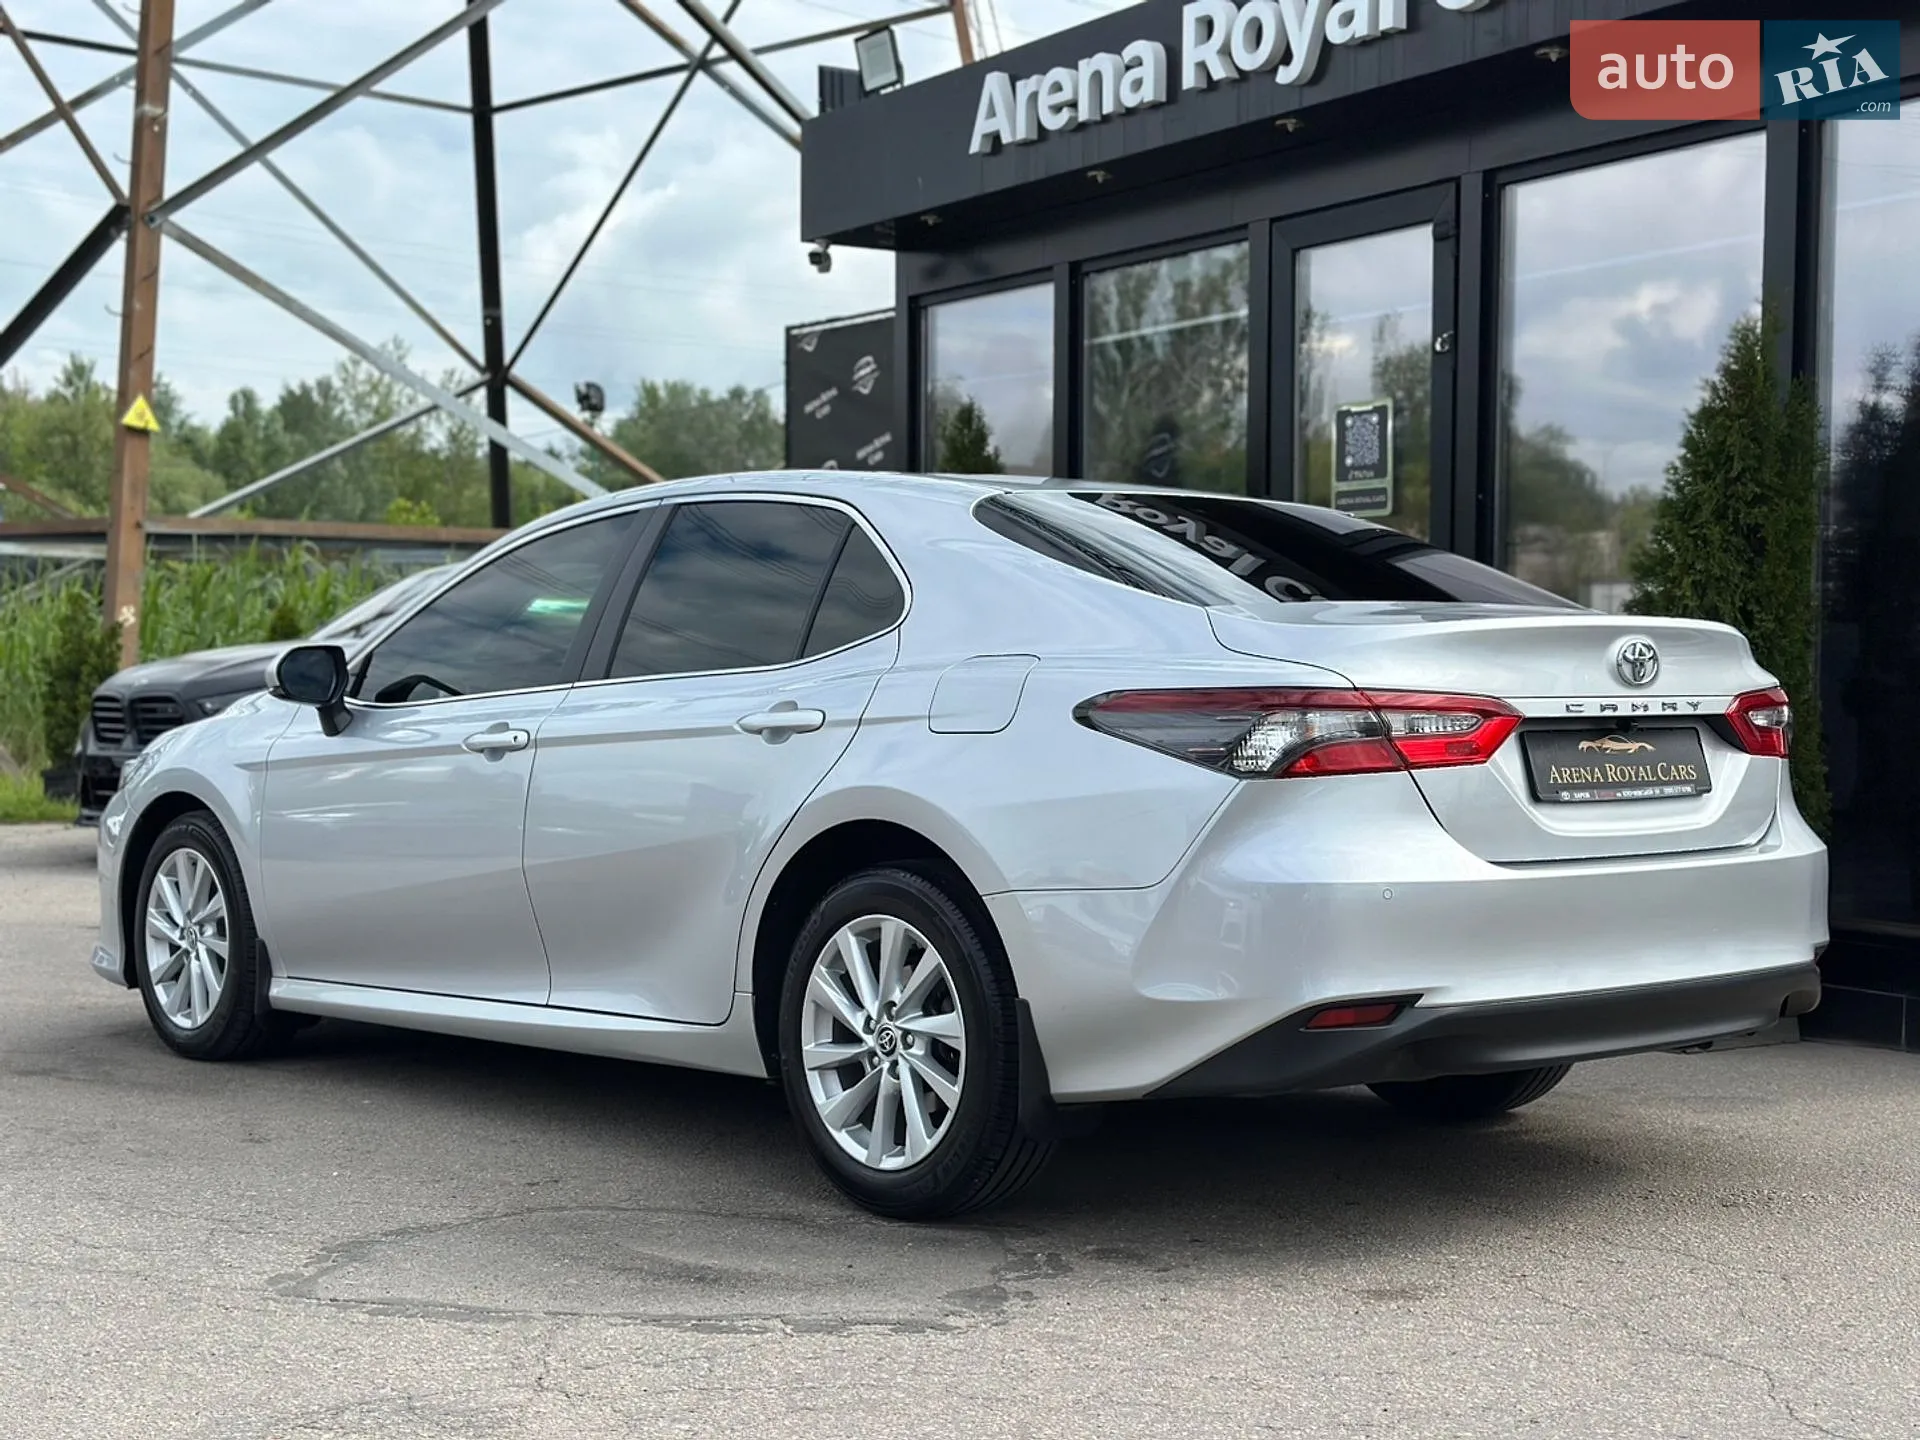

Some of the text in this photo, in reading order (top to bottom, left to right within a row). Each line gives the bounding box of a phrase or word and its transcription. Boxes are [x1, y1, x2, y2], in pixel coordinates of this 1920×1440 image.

[968, 40, 1167, 155] Arena
[1565, 701, 1702, 713] CAMRY
[1549, 761, 1697, 784] ARENA ROYAL CARS
